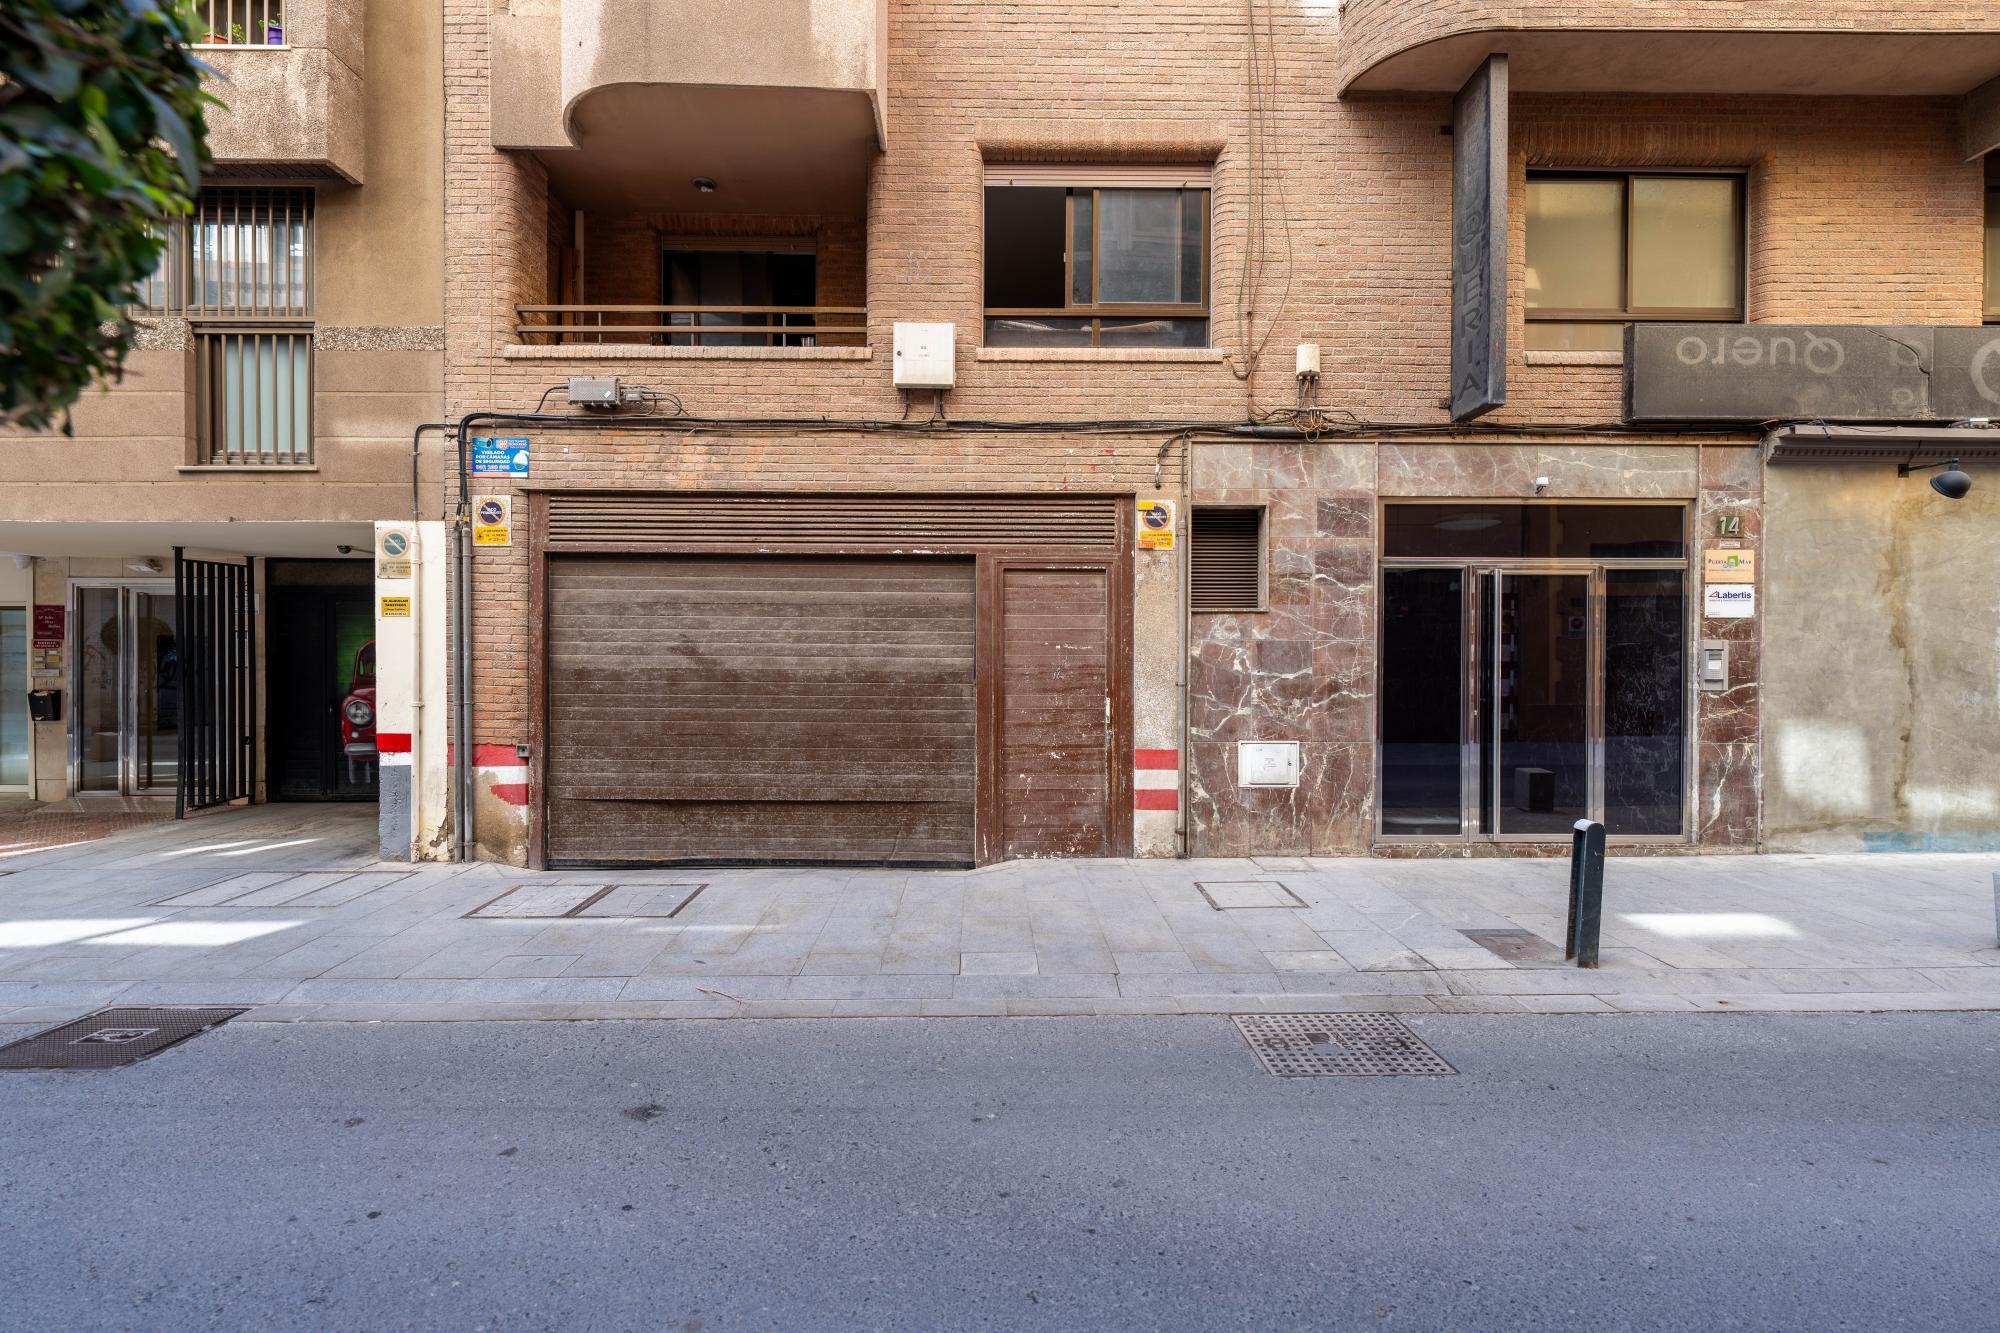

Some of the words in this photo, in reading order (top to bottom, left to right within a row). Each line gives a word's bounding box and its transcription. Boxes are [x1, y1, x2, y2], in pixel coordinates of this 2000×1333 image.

[1676, 329, 1845, 374] Quero
[1719, 516, 1740, 535] 14
[1717, 591, 1752, 599] Labertis
